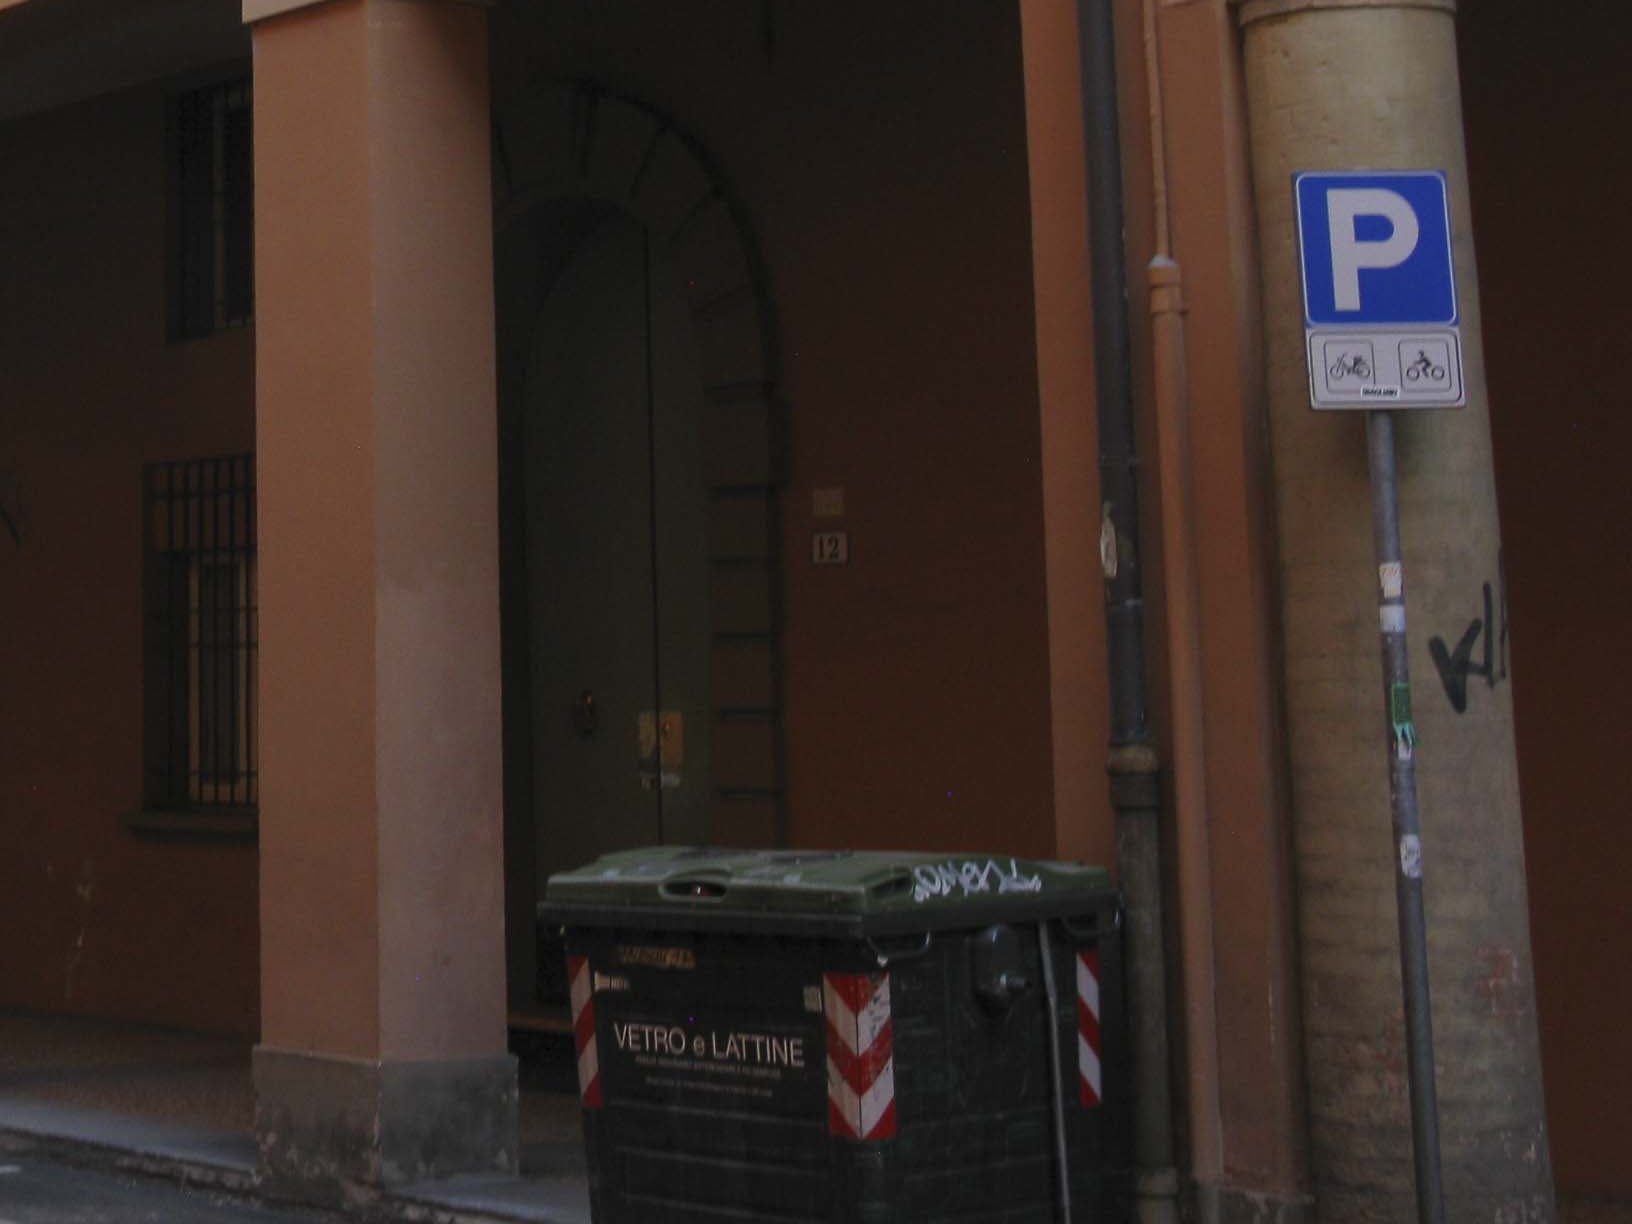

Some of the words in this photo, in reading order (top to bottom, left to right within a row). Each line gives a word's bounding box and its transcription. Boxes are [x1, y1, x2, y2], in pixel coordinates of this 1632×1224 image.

[1326, 187, 1420, 313] P
[818, 535, 839, 559] 12
[614, 1022, 686, 1056] VETRO
[693, 1034, 705, 1057] e
[712, 1030, 805, 1068] LATTINE
